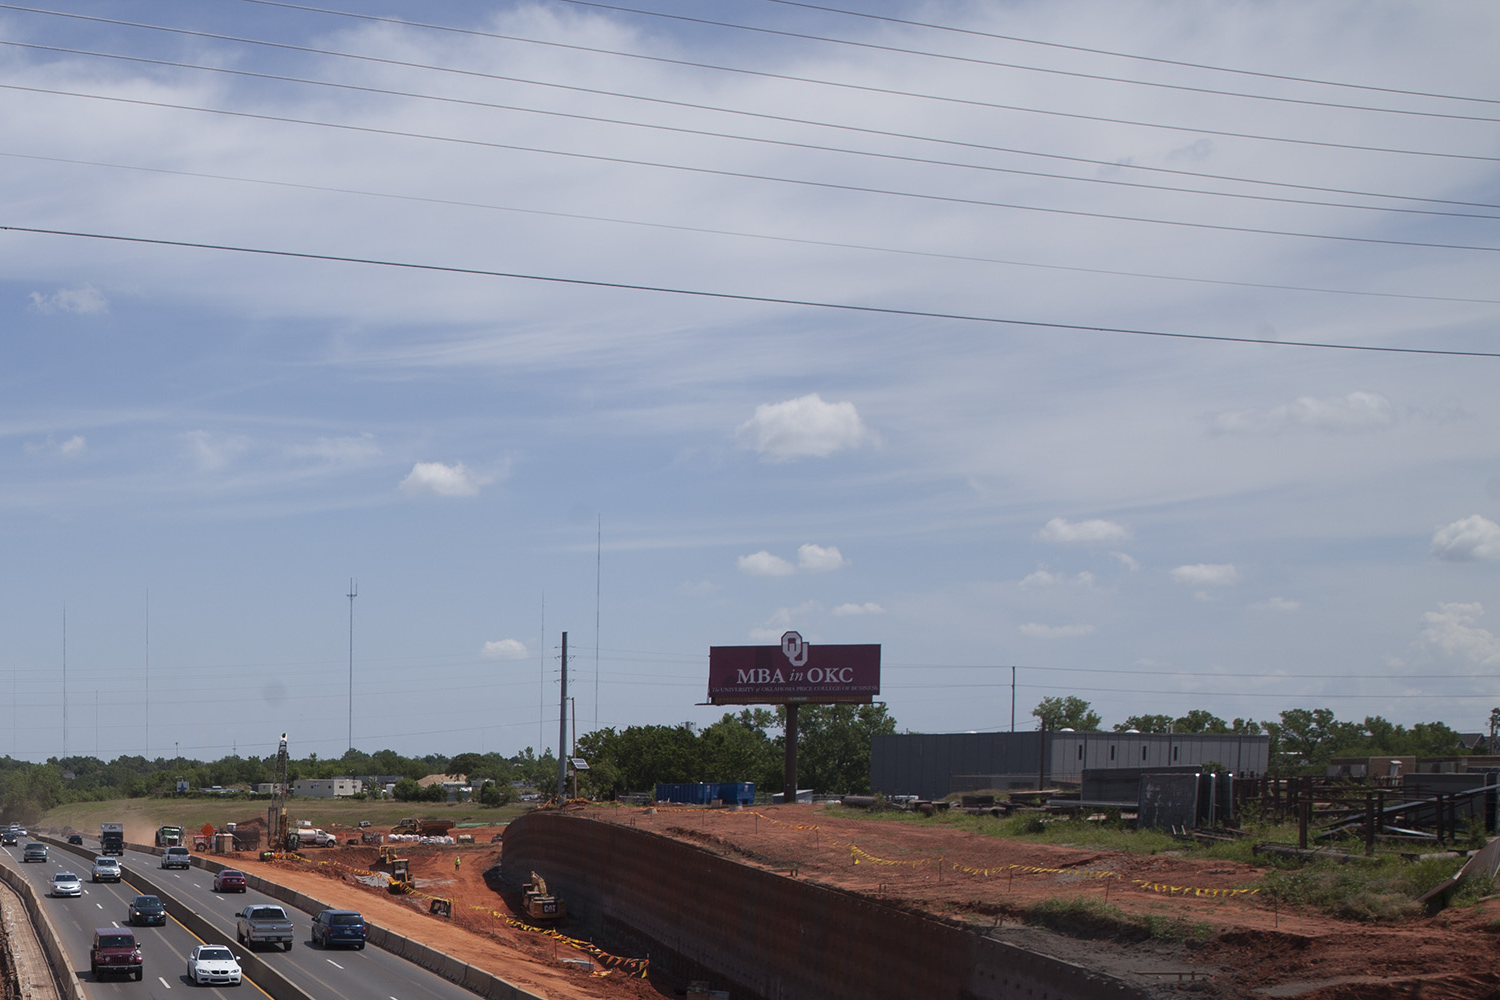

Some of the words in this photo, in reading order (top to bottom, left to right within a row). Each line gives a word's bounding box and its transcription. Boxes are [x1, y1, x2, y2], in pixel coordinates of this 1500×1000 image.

[736, 668, 786, 684] MBA
[789, 669, 804, 682] in
[807, 667, 854, 683] OKC
